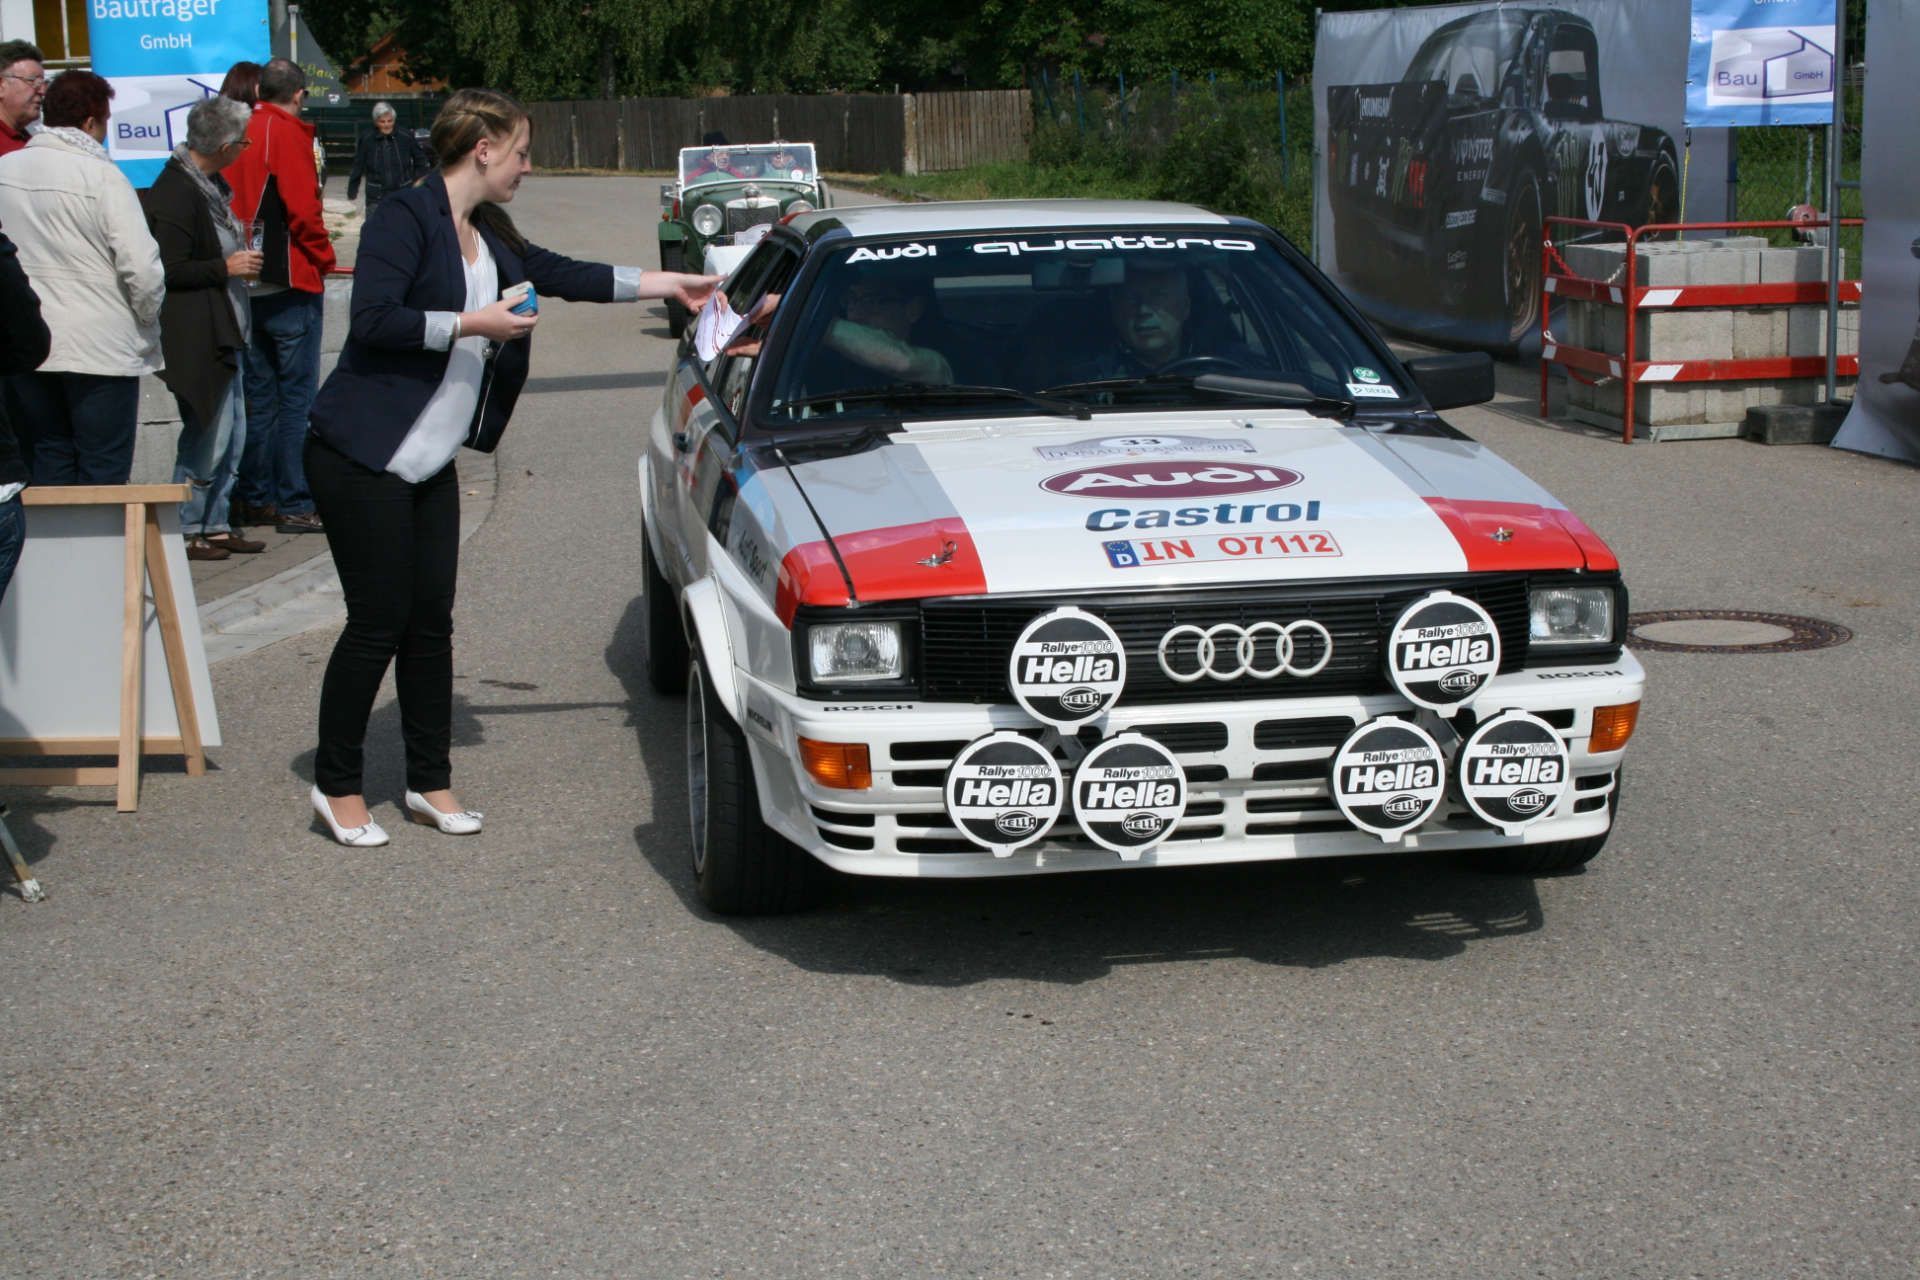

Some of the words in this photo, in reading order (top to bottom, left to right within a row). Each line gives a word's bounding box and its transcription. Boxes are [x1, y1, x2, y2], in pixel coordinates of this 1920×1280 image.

[140, 33, 192, 49] GmbH
[1718, 71, 1758, 86] Bau
[1793, 71, 1824, 80] GmbH
[118, 123, 160, 139] Bau
[845, 243, 938, 264] Audi
[972, 235, 1257, 256] quattro
[1119, 438, 1161, 446] 33
[1061, 467, 1281, 492] Audi
[1085, 500, 1320, 532] Castrol
[1142, 539, 1196, 562] IN
[1418, 626, 1453, 639] Rallye
[1455, 622, 1488, 637] 1000
[1041, 643, 1078, 654] Rallye
[1080, 641, 1114, 654] 1000
[1403, 638, 1489, 669] Hella
[1024, 656, 1114, 683] Hella
[1536, 670, 1624, 679] BOSCH
[1442, 674, 1478, 686] HELLA
[1063, 692, 1101, 704] HELLA
[823, 704, 914, 712] BOSCH
[1363, 751, 1398, 763] Rallye
[1400, 747, 1433, 761] 1000
[1491, 745, 1527, 756] Rallye
[1528, 743, 1559, 756] 1000
[978, 766, 1015, 777] Rallye
[1017, 765, 1052, 777] 1000
[1103, 769, 1140, 779] Rallye
[1142, 766, 1175, 779] 1000
[1347, 763, 1434, 793] Hella
[1474, 758, 1559, 784] Hella
[961, 780, 1052, 806] Hella
[1087, 781, 1176, 808] Hella
[1511, 794, 1545, 805] HELLA
[1386, 799, 1421, 810] HELLA
[999, 817, 1037, 828] HELLA
[1125, 818, 1162, 829] HELLA
